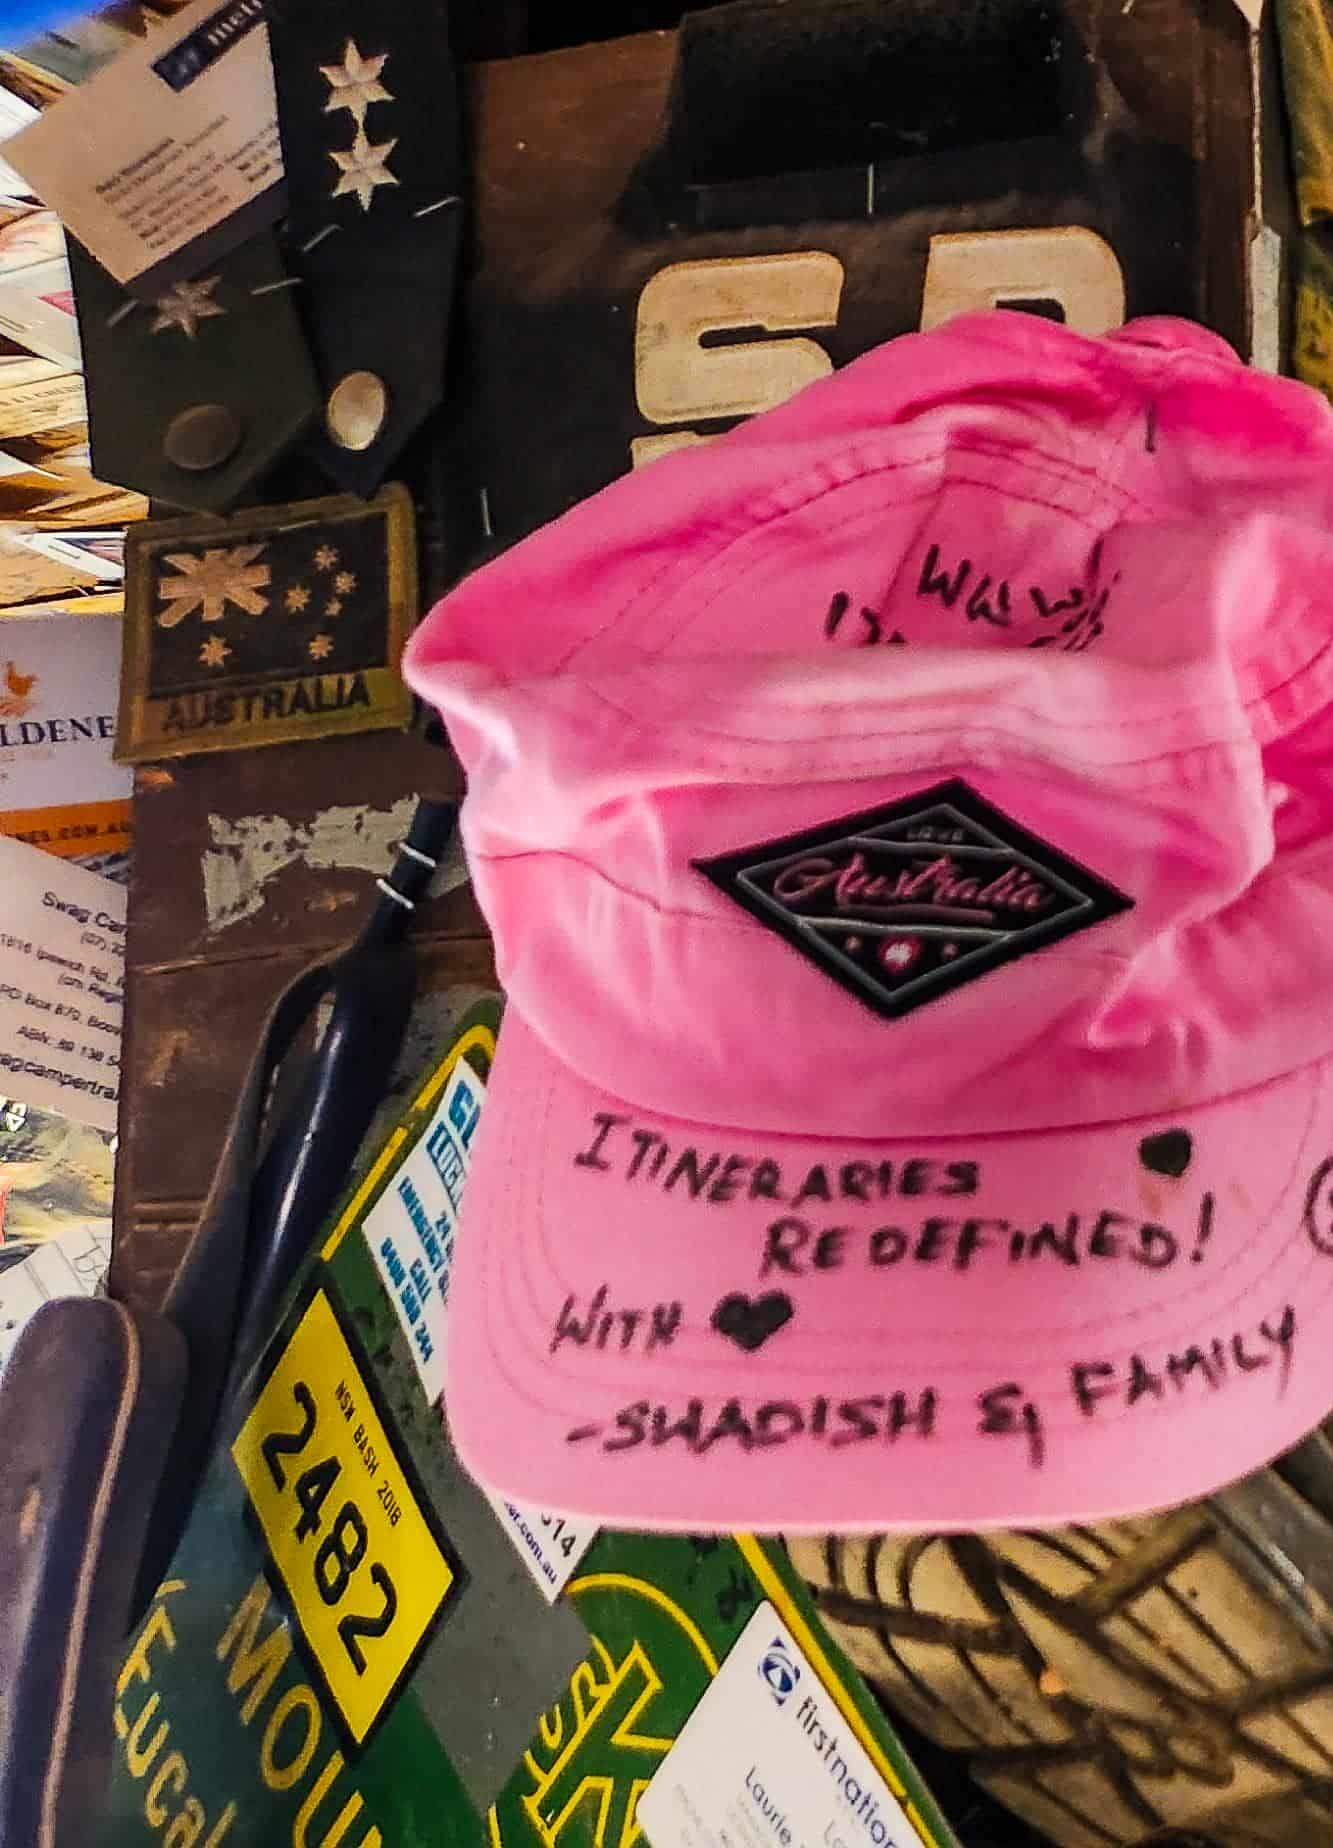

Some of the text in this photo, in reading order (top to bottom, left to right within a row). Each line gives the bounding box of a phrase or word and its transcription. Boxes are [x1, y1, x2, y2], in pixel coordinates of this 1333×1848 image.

[161, 672, 373, 736] AUSTRALIA
[772, 850, 1044, 914] Australia
[575, 1110, 982, 1207] ITINERARIES
[757, 1190, 1216, 1279] REDEFINED!
[549, 1282, 684, 1354] WITH
[1071, 1303, 1298, 1418] FAMILY
[334, 1378, 356, 1424] NSW
[352, 1423, 379, 1479] BASH
[261, 1380, 398, 1677] 2482
[744, 1765, 793, 1844] Laurie
